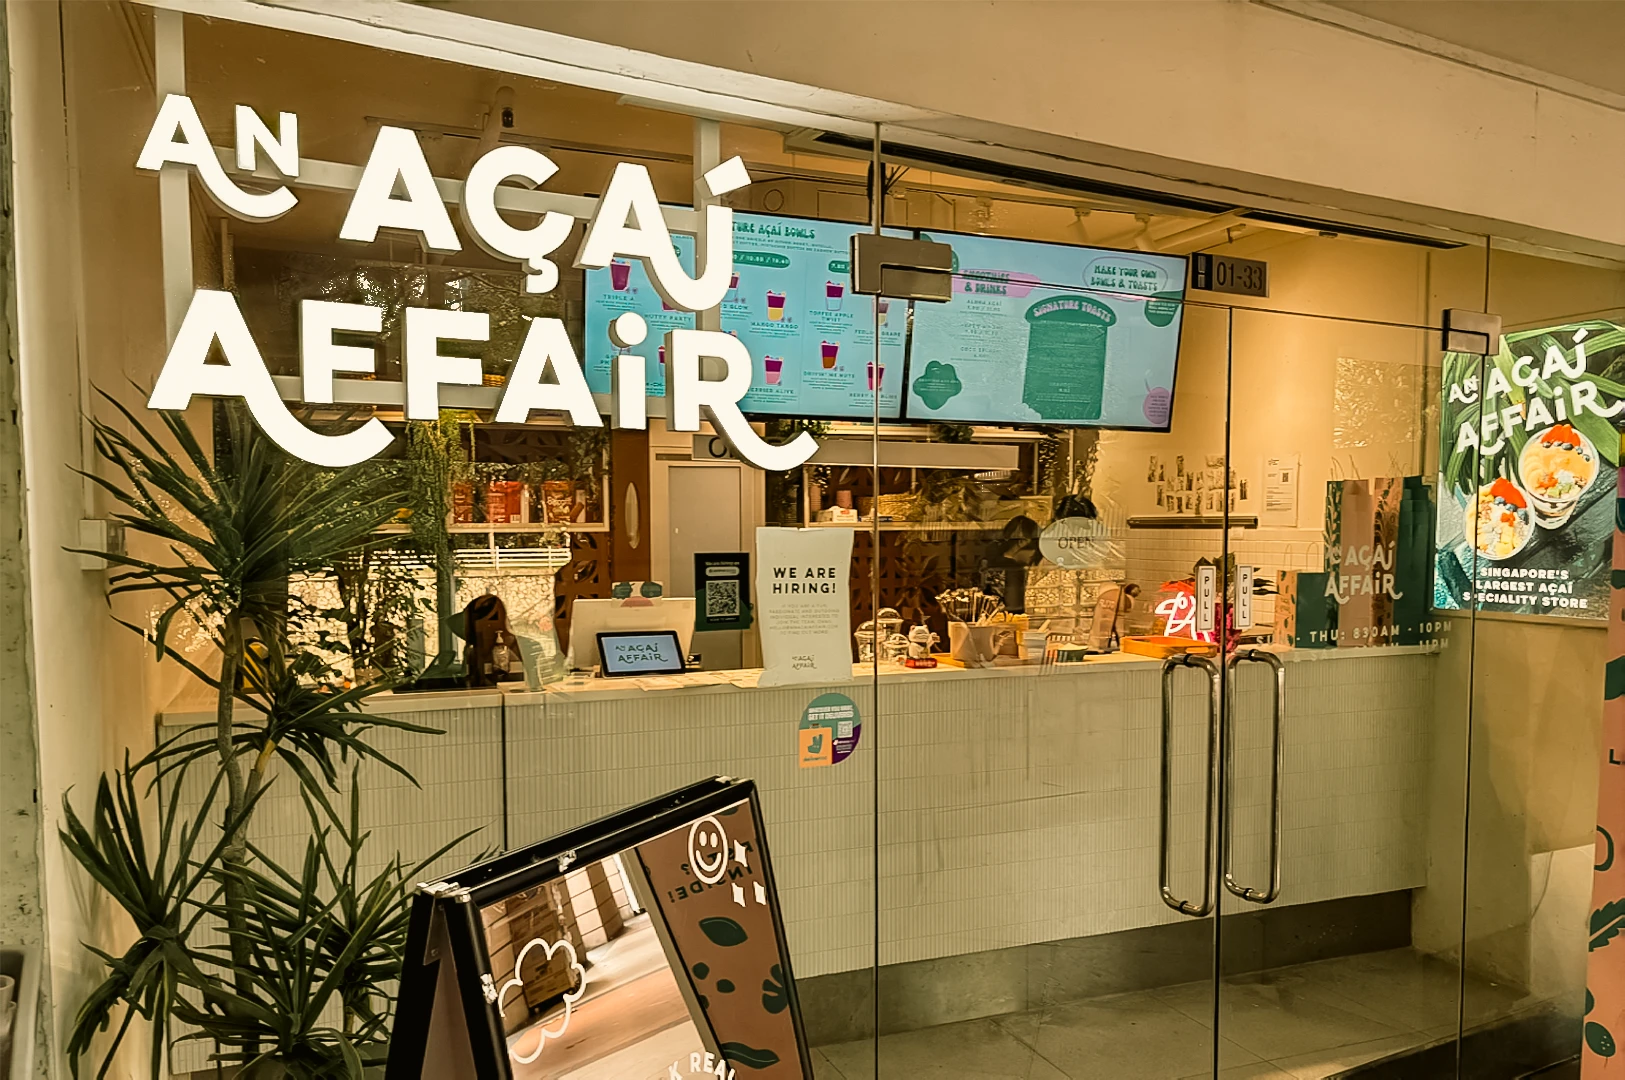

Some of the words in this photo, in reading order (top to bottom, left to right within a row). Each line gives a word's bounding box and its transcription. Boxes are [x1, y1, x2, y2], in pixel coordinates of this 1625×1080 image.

[136, 93, 300, 218] AN
[339, 125, 752, 310] AÇAÍ
[784, 226, 815, 240] BOWLS
[1094, 265, 1116, 275] MAKE
[1118, 267, 1138, 277] YOUR
[1141, 269, 1157, 279] OWN
[1216, 261, 1263, 291] 01-33
[964, 281, 972, 292] &
[975, 283, 1007, 295] DRINKS
[1090, 277, 1116, 287] BOWLS
[1118, 279, 1125, 289] &
[1128, 280, 1158, 291] TOASTS
[1034, 300, 1079, 317] SIGNATURE
[1081, 301, 1112, 323] TOASTS
[1448, 375, 1480, 404] AN
[1485, 328, 1588, 401] AÇAÍ
[1058, 536, 1094, 549] OPEN
[773, 567, 797, 578] WE
[804, 567, 836, 578] ARE
[1480, 566, 1569, 580] SINGAPORE'S
[772, 582, 836, 594] HIRING!
[1475, 580, 1534, 592] LARGEST
[1538, 581, 1574, 596] AÇAÍ
[1541, 596, 1588, 609] STORE
[1309, 629, 1346, 643] THU:
[1353, 624, 1400, 639] 830AM
[1419, 621, 1452, 634] 10PM
[628, 642, 658, 653] AÇAÍ
